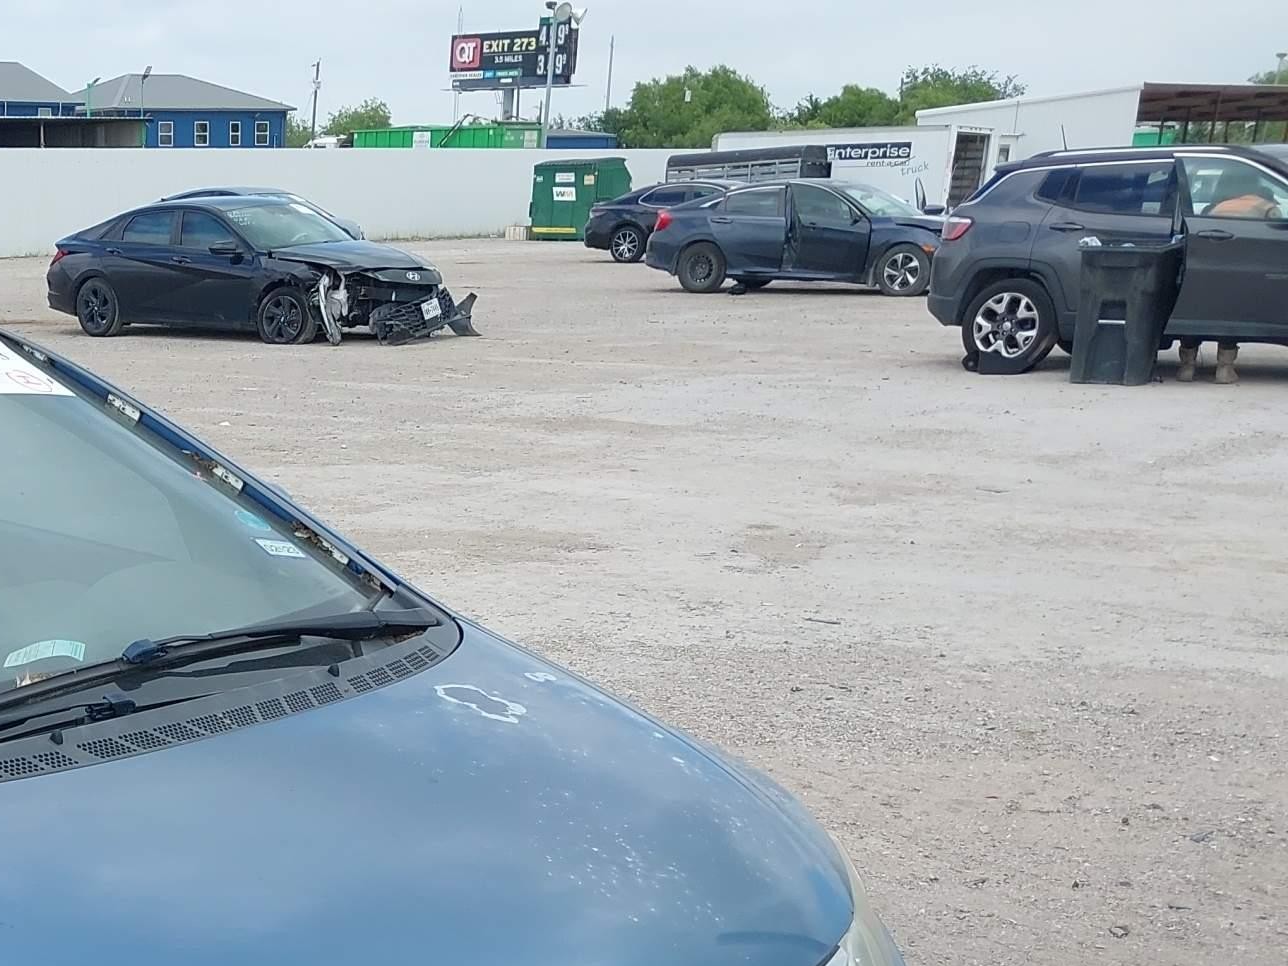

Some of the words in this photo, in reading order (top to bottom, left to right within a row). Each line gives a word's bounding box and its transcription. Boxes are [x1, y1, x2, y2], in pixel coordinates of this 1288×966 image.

[455, 43, 476, 63] QT
[483, 40, 510, 53] EXIT
[513, 37, 536, 51] 273
[827, 145, 910, 161] Enterprise
